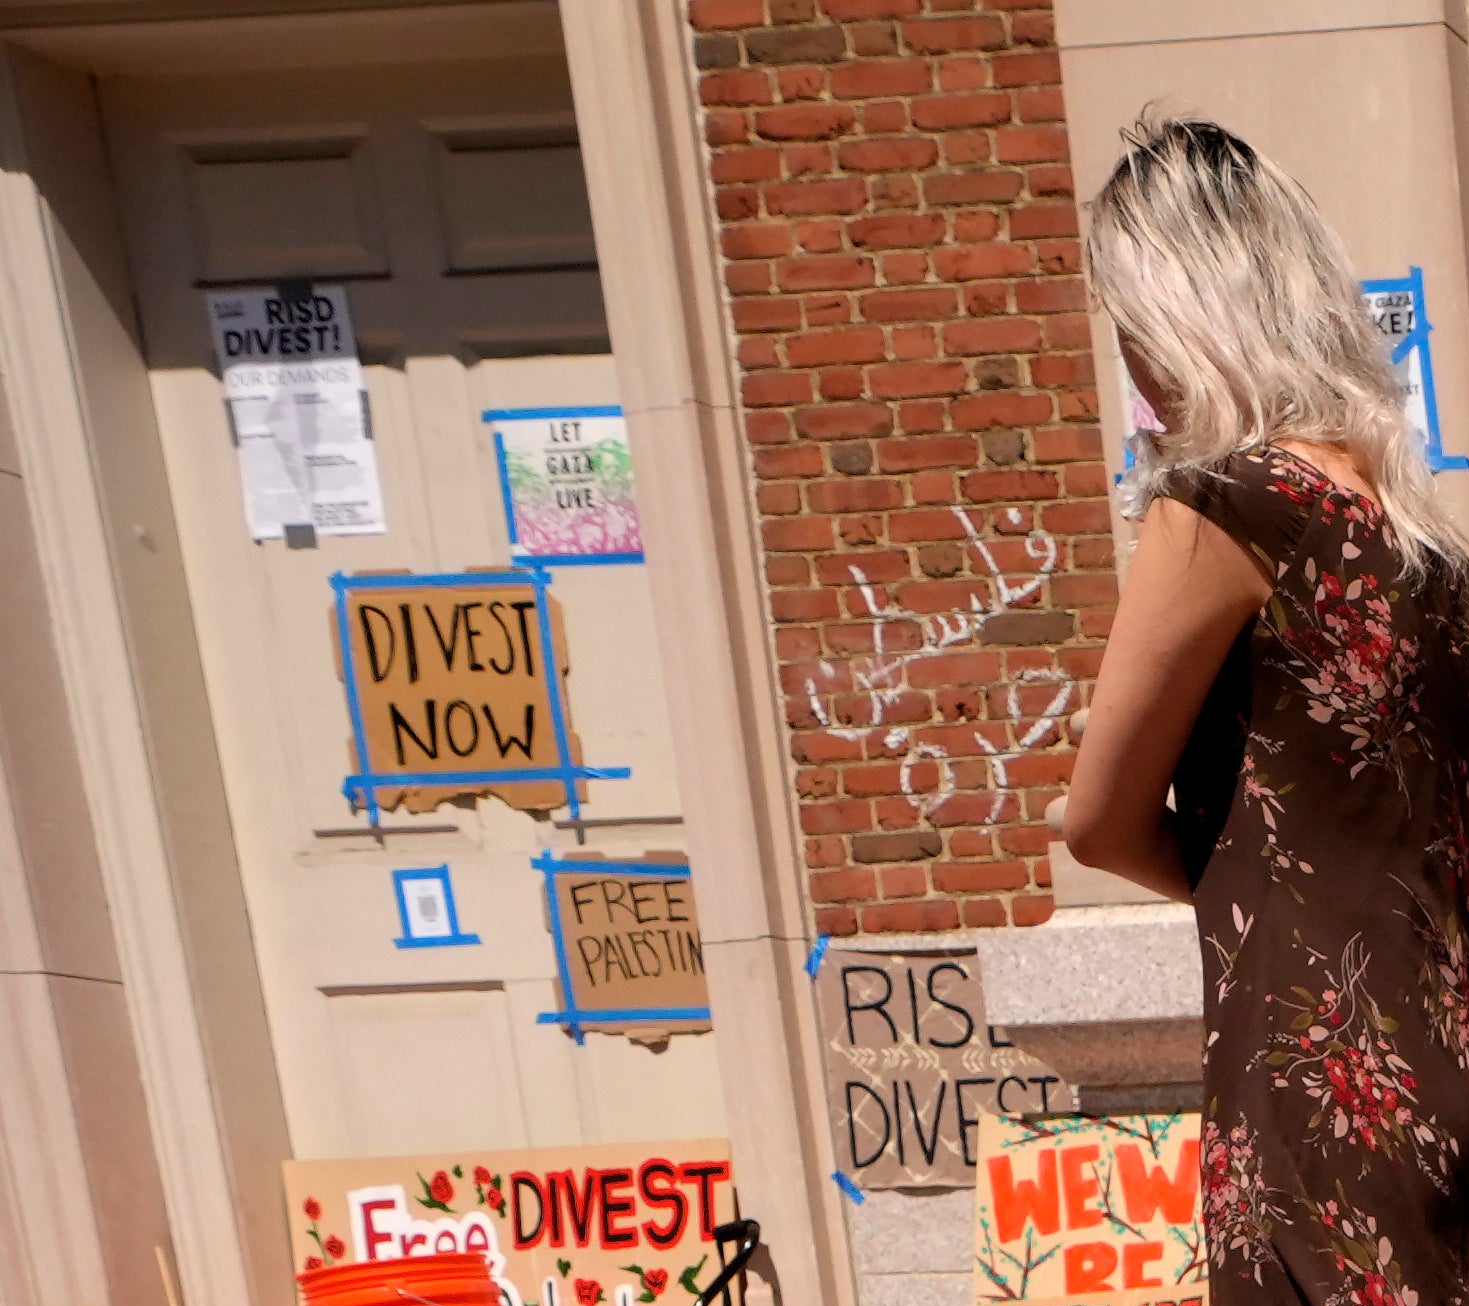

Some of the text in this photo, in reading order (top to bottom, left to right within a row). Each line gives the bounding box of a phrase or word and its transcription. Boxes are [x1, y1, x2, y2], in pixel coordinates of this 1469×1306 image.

[265, 296, 334, 325] RISD
[224, 325, 341, 356] DIVEST!
[550, 421, 581, 442] LET
[546, 451, 594, 475] GAZA
[555, 487, 597, 509] LIVE
[358, 600, 538, 684] DIVEST
[389, 699, 535, 766] NOW
[570, 879, 689, 926] FREE
[576, 928, 705, 987] PALESTIN
[842, 963, 1013, 1048] RIS
[511, 1159, 731, 1250] DIVEST
[987, 1146, 1101, 1244] WE
